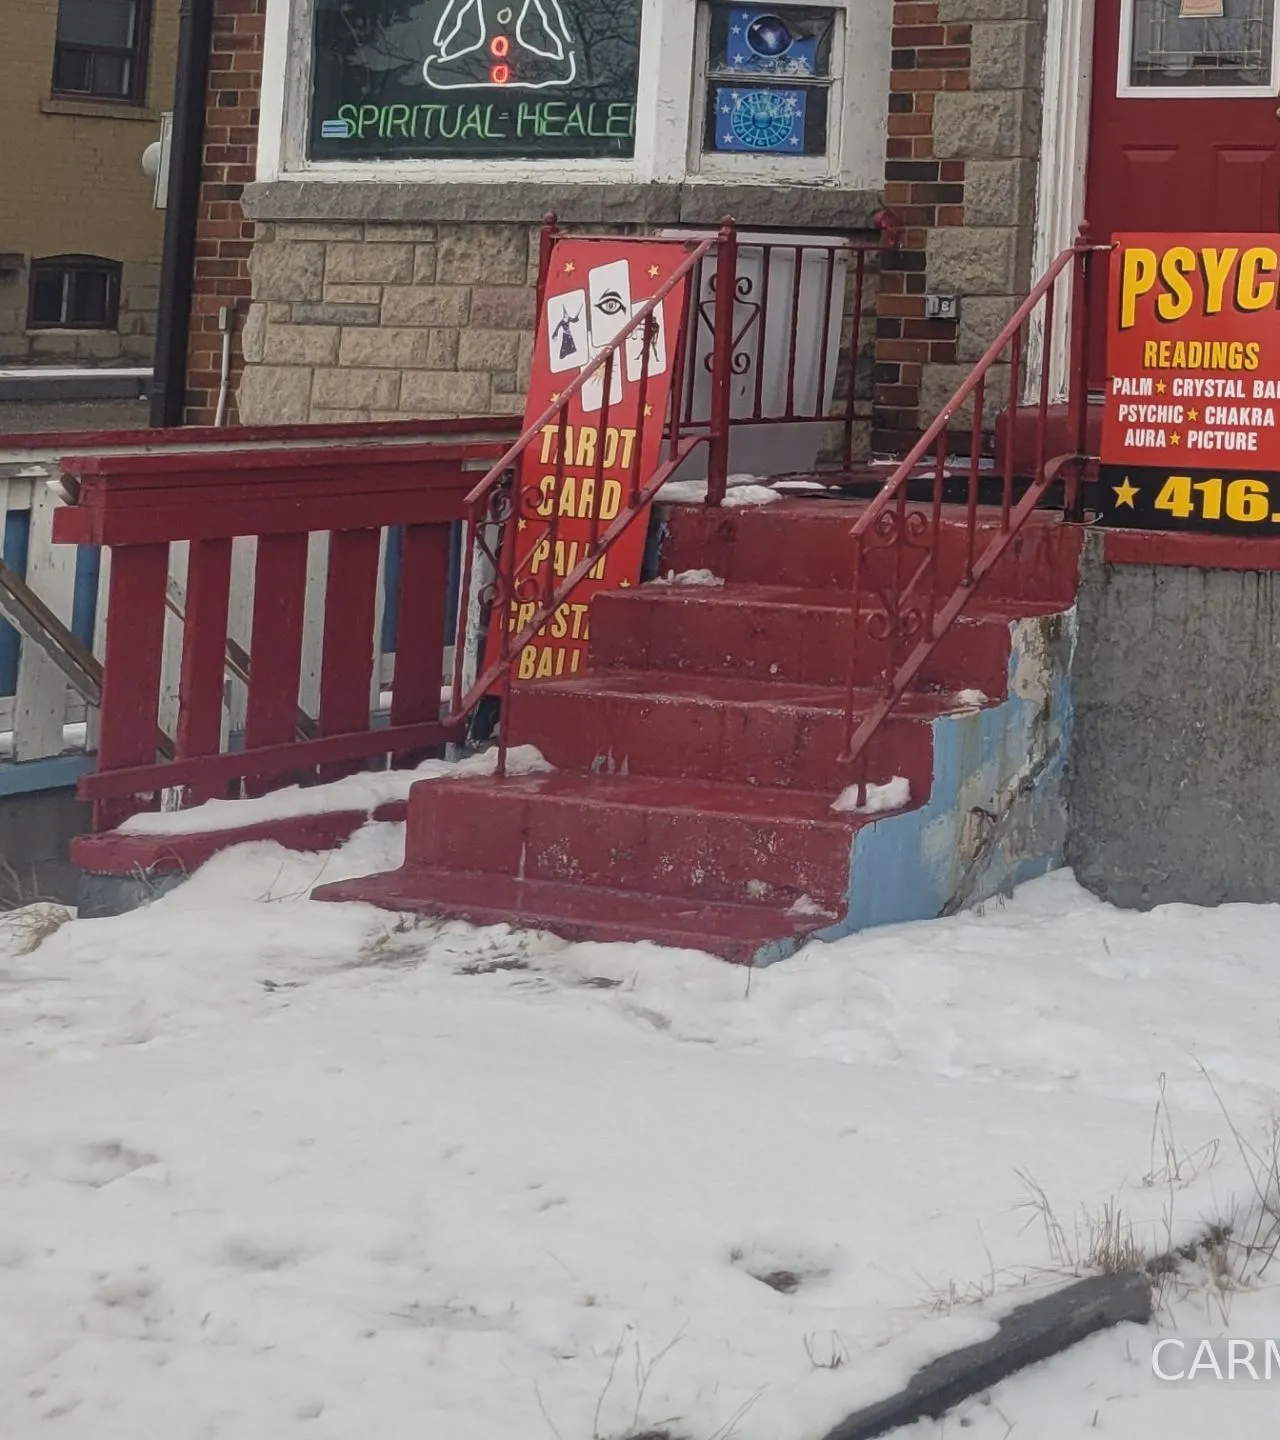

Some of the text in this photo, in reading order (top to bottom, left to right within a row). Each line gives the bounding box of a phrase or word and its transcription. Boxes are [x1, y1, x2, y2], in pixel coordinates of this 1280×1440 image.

[338, 103, 507, 139] SPIRITUAL
[1144, 340, 1260, 370] READINGS
[1112, 377, 1153, 396] PALM
[1172, 378, 1246, 398] CRYSTAL
[1118, 404, 1275, 427] PSYCHIC CHAKRA
[1124, 428, 1258, 451] AURA PICTURE
[536, 474, 622, 520] CARD
